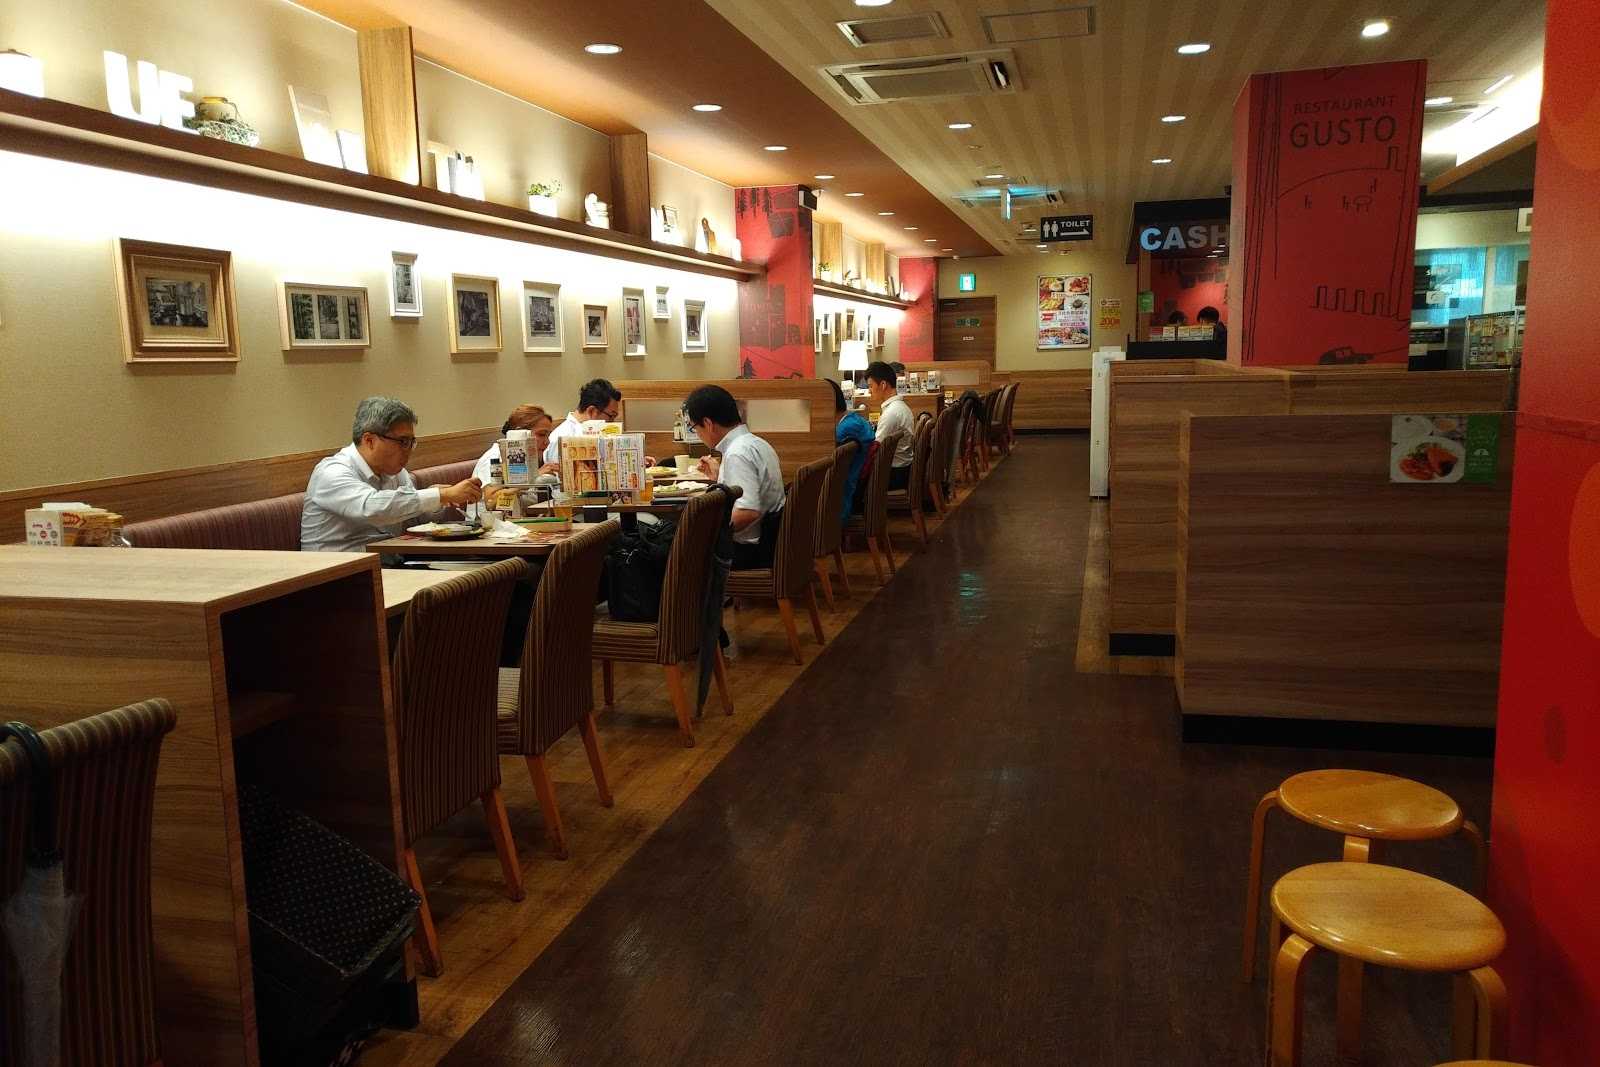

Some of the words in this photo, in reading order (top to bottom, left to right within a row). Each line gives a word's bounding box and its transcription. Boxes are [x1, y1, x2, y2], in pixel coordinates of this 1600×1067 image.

[1294, 95, 1396, 114] RESTAURANT
[1290, 114, 1395, 148] GUSTO
[1060, 220, 1090, 228] TOILET
[1140, 225, 1230, 251] CASH
